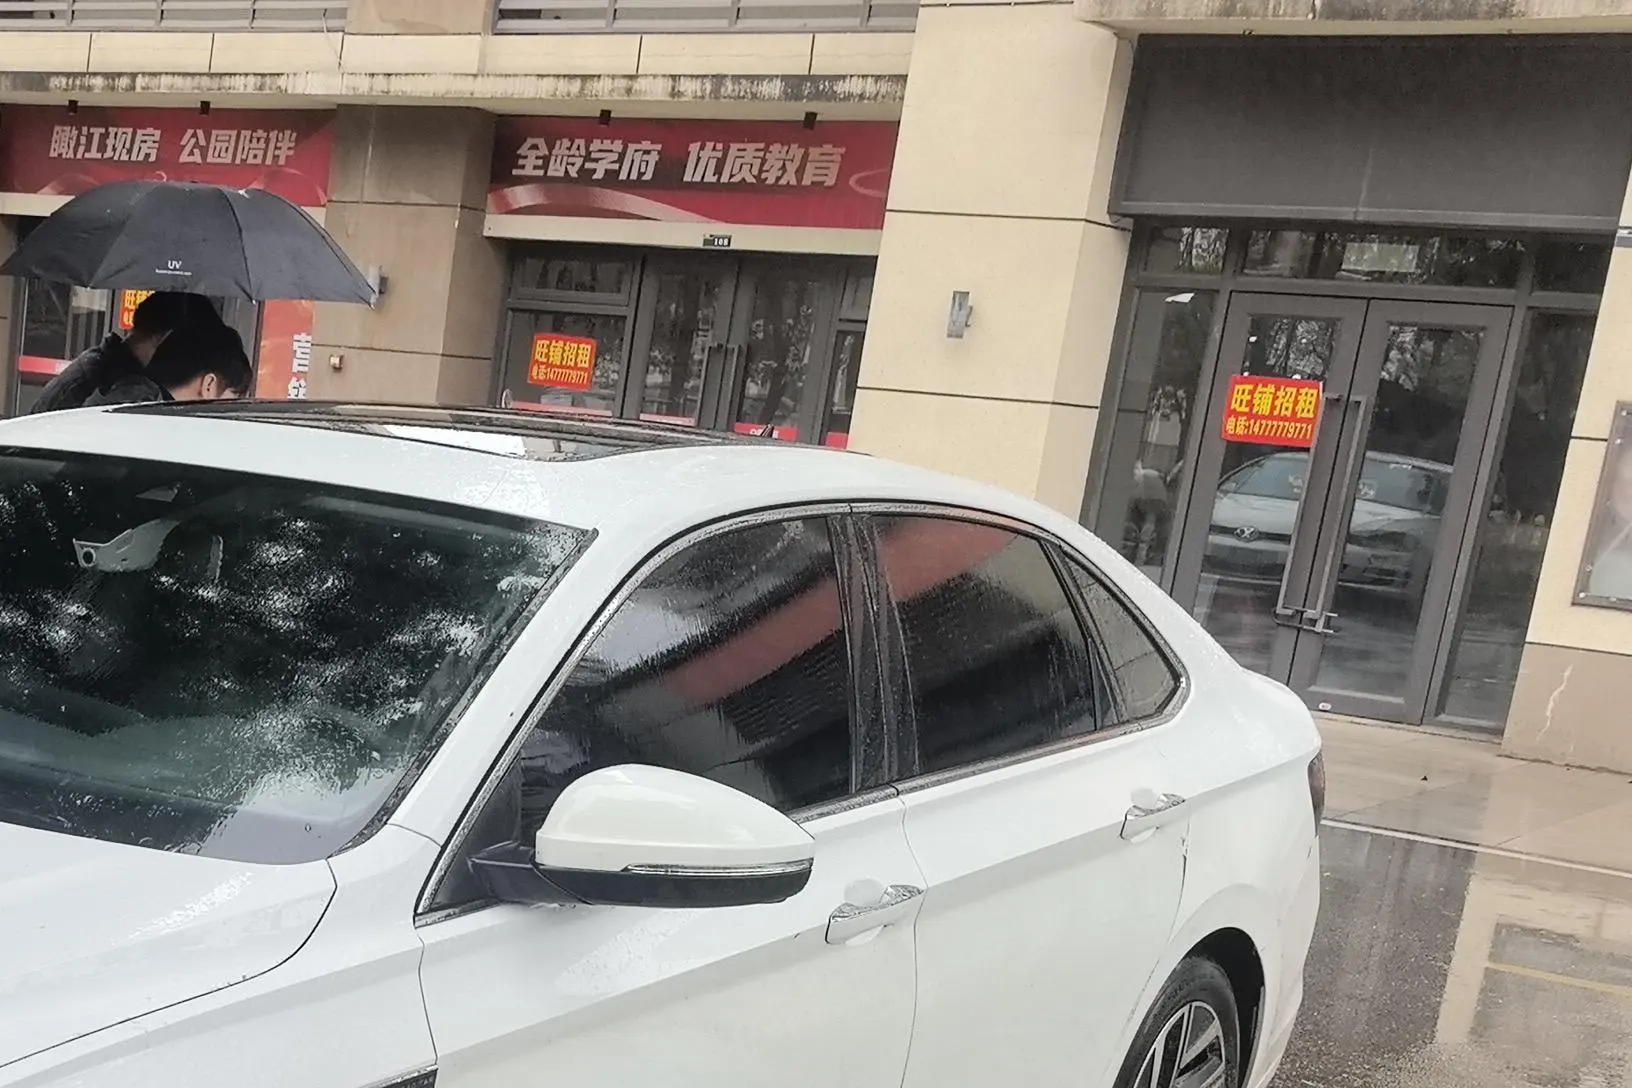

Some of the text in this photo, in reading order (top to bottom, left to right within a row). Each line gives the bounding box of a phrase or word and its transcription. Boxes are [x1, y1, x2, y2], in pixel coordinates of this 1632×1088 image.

[48, 125, 298, 165] 瞰江现房 公园陪伴
[512, 137, 845, 187] 全龄学府 优质教育
[535, 340, 591, 368] 旺铺招租
[1231, 383, 1318, 418] 旺铺招租
